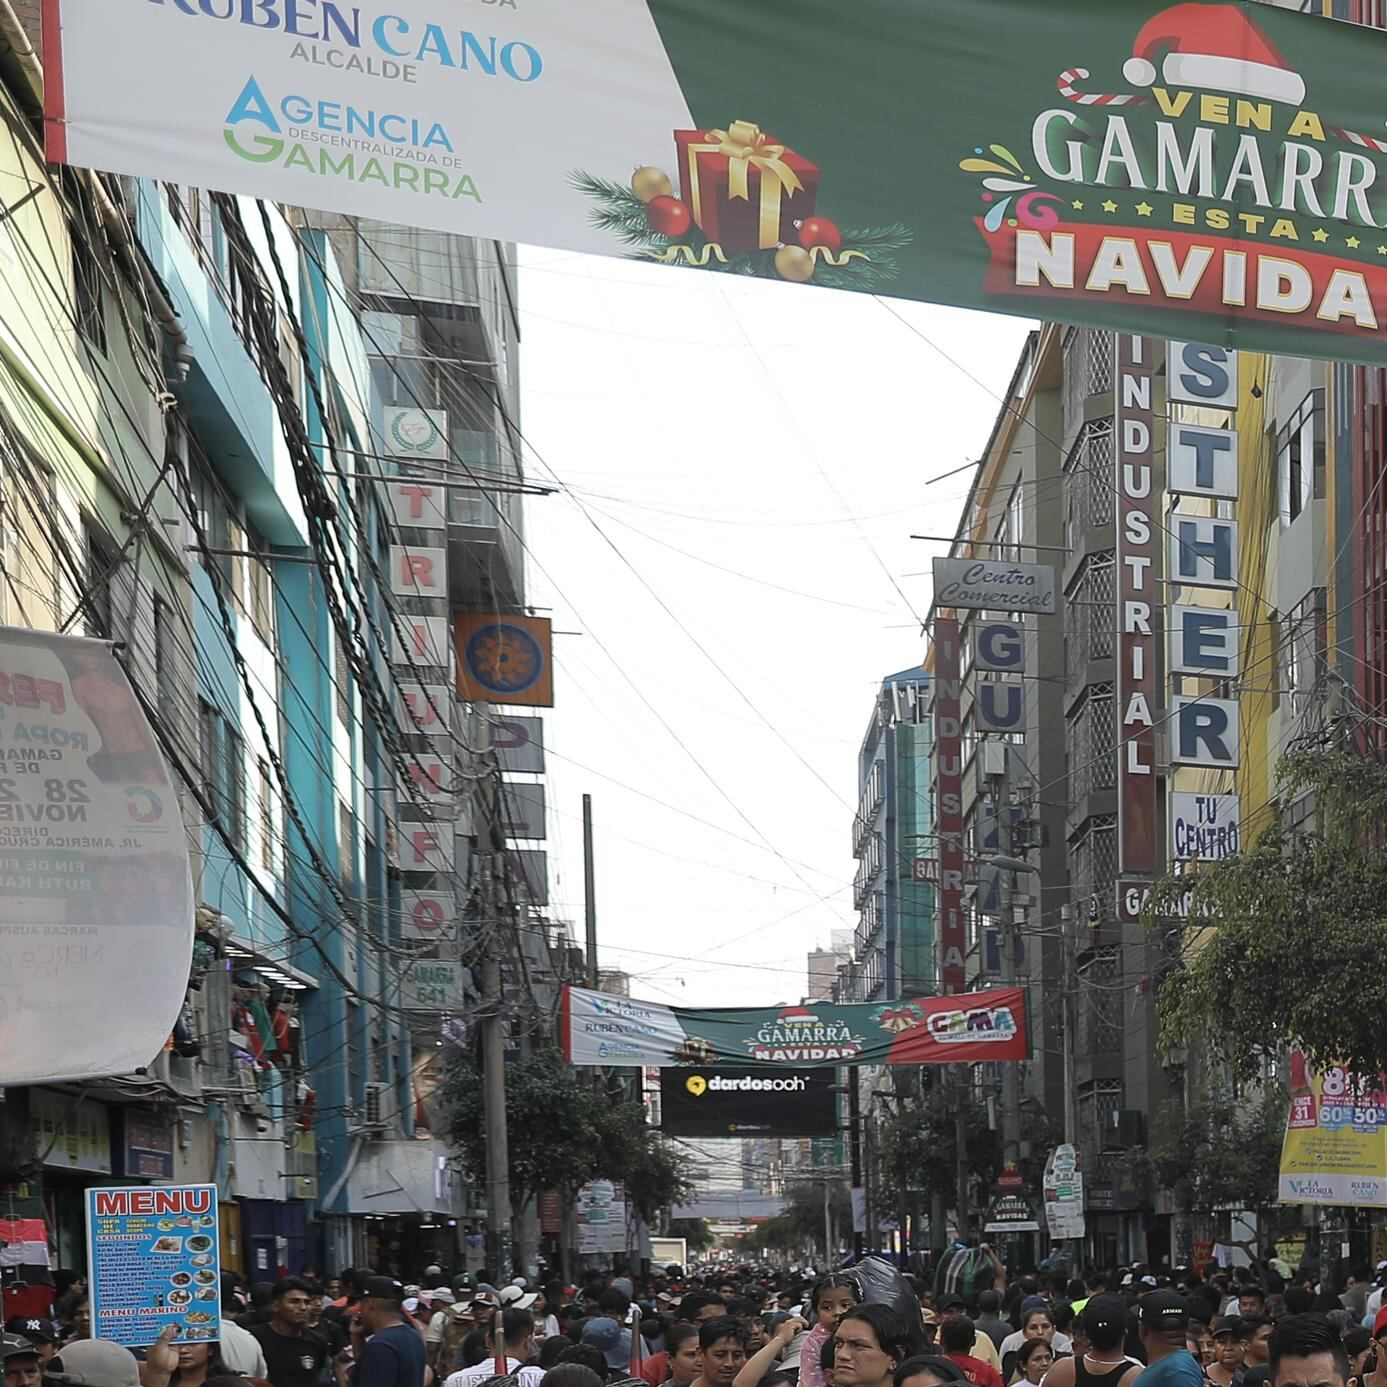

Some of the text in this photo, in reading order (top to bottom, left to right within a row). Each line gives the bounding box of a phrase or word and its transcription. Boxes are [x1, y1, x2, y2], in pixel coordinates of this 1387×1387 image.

[289, 42, 418, 84] ALCALDE
[372, 14, 543, 83] CANO
[224, 74, 454, 153] AGENCIA
[1151, 86, 1327, 141] VEN A
[288, 126, 463, 169] DESCENTRALIZADA DE
[223, 129, 483, 204] GAMARRA
[1172, 203, 1300, 242] ESTA
[963, 564, 1036, 587] Centro
[939, 582, 1053, 608] Comercial
[1196, 796, 1217, 824] TU
[1175, 815, 1239, 858] CENTRO
[758, 1028, 851, 1042] GAMARRA
[755, 1049, 856, 1062] NAVIDAD
[708, 1076, 806, 1091] dardosooh
[95, 1189, 211, 1217] MENU
[138, 1305, 189, 1316] MARINO
